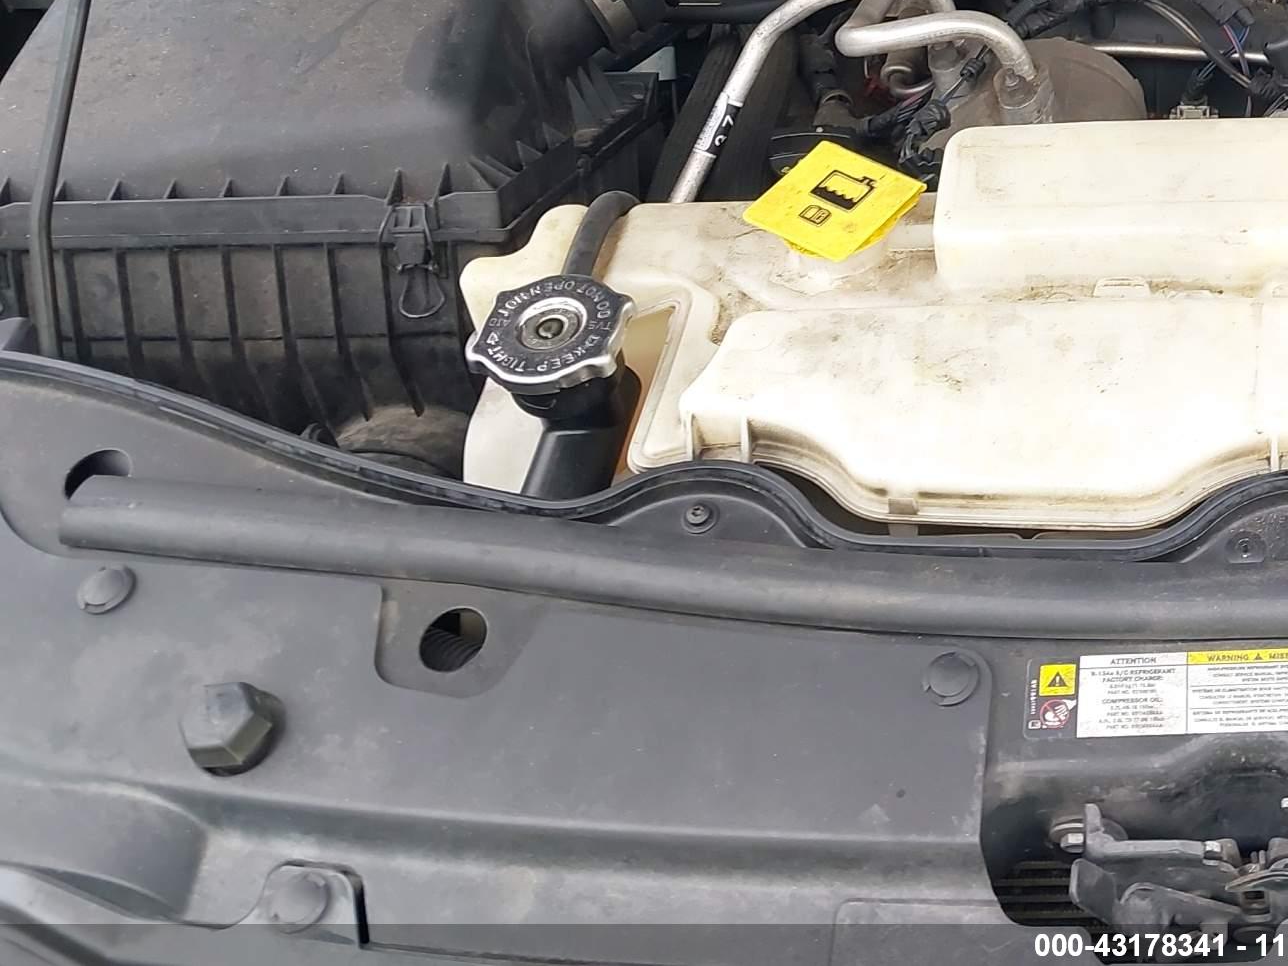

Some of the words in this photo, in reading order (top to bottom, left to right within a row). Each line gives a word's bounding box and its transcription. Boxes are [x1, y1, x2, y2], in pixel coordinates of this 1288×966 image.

[576, 284, 605, 302] NOT
[1110, 657, 1157, 665] ATTENTION
[1207, 654, 1249, 662] WARNING
